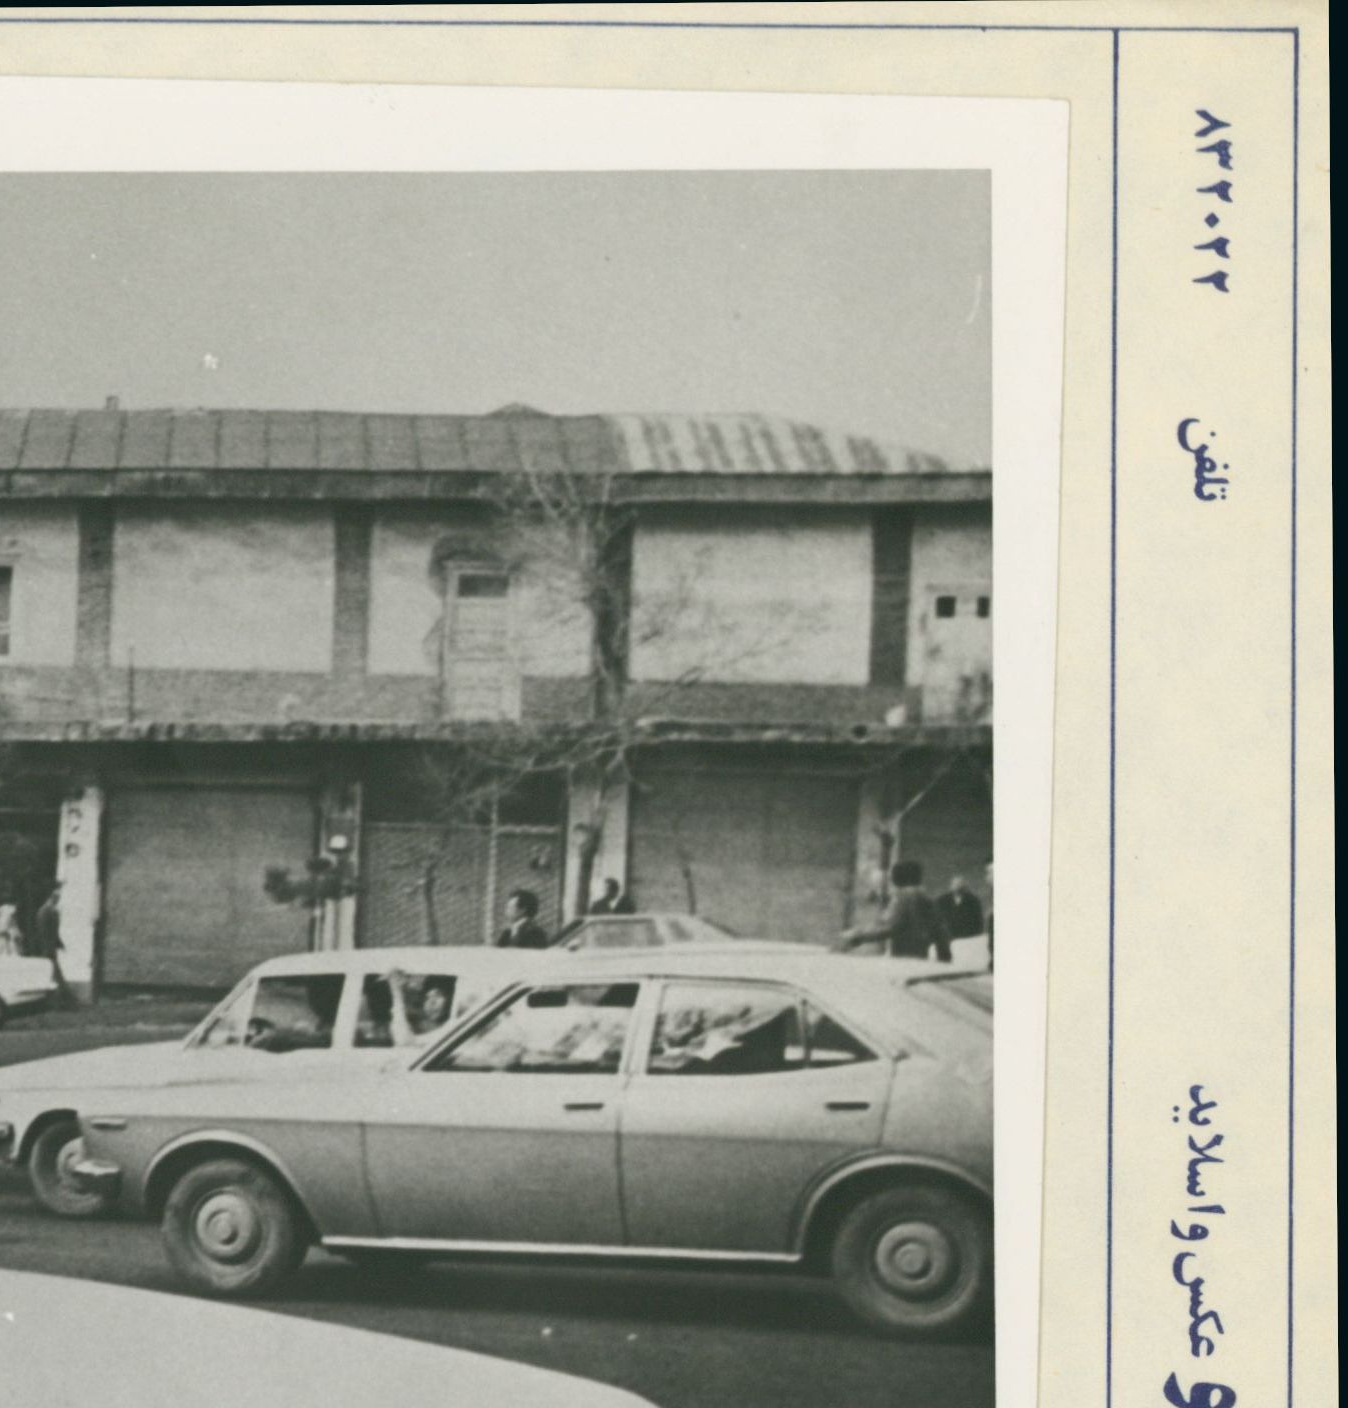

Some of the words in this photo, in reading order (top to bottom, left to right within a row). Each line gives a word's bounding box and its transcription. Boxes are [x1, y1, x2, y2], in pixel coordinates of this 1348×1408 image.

[1193, 109, 1233, 293] ۸۳۲۰۲۲
[1177, 418, 1229, 501] تلفن
[1172, 1085, 1226, 1214] اسلاید
[1170, 1220, 1209, 1241] و
[1172, 1252, 1224, 1358] عکس
